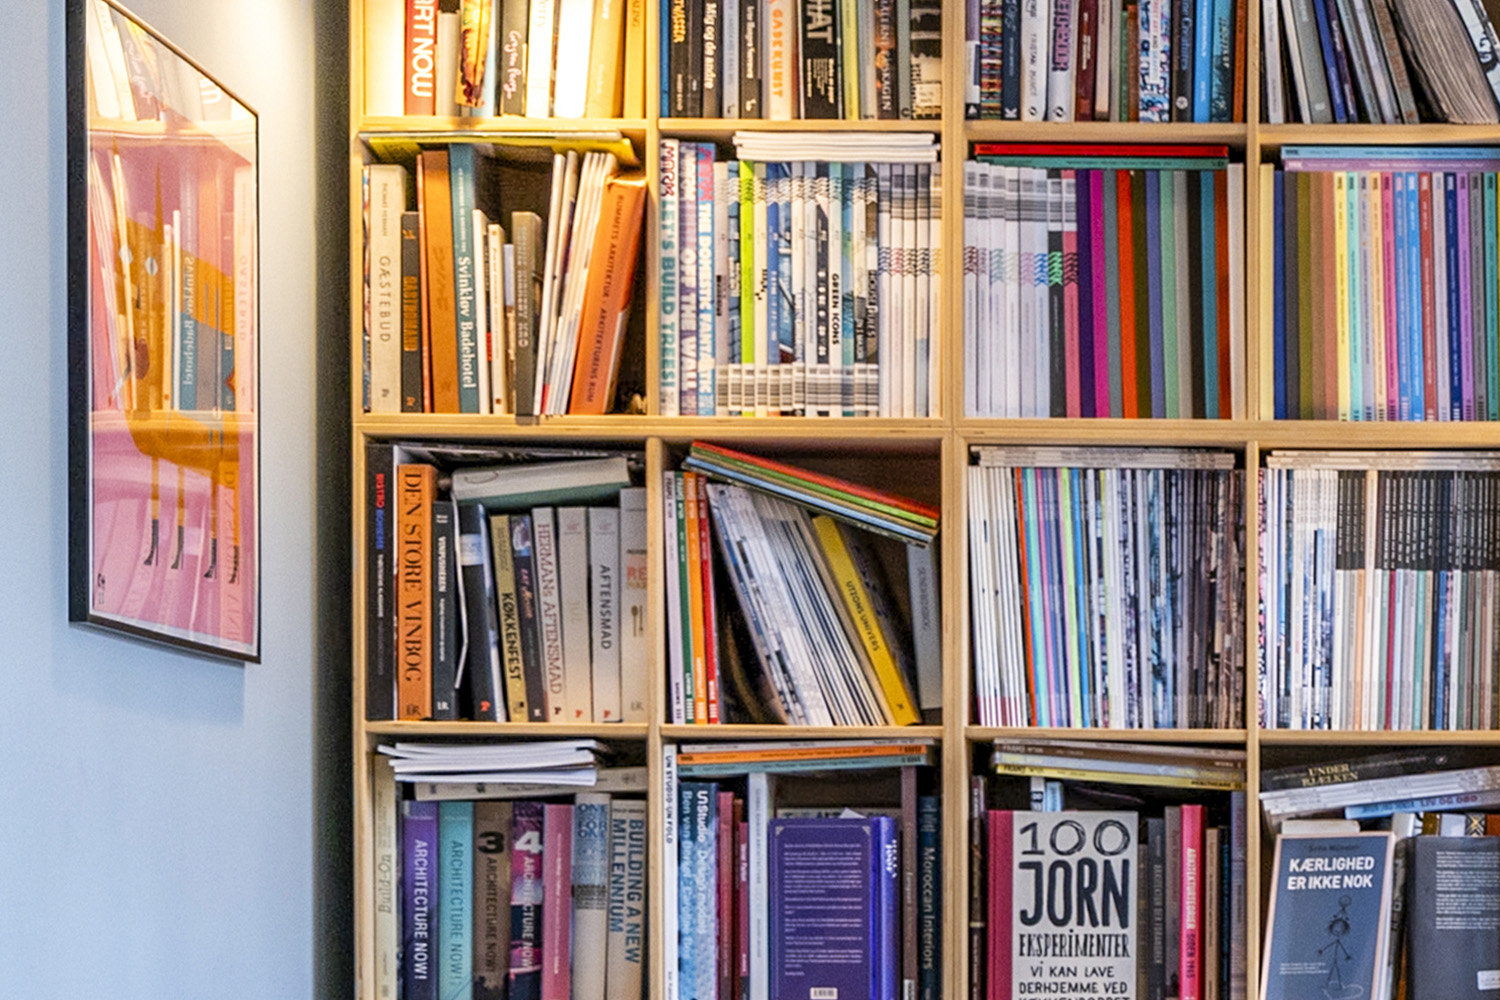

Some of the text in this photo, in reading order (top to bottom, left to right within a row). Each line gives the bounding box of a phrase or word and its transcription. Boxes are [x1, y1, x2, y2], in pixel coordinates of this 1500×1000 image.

[412, 38, 435, 97] NOW
[703, 3, 717, 89] Mig og de andre
[772, 9, 783, 97] GADEKUNST
[379, 256, 391, 343] GÆSTEBUD
[458, 256, 476, 317] Svinkløv
[590, 195, 625, 380] RUMMETS ARKITEKTUR ARKITEKTURENS
[661, 256, 675, 316] BUILD
[831, 273, 839, 345] GREEN ICONS
[459, 320, 480, 388] Badehotel
[661, 322, 675, 388] TREES!
[681, 337, 696, 391] WALL
[402, 472, 422, 683] DEN STORE VINBOG
[600, 564, 613, 650] AFTENSMAD
[501, 592, 522, 681] KØKKENFEST
[548, 601, 565, 695] AFTENSMAD
[861, 614, 880, 652] UNIVERS
[665, 755, 674, 845] UN STUDIO UN FOLD
[681, 790, 692, 813] Ben
[1307, 763, 1350, 777] UNDER
[610, 819, 625, 933] MILLENNIUM
[1019, 819, 1131, 857] 100
[1288, 856, 1376, 873] KÆRLIGHED
[413, 839, 429, 980] ARCHITECTURE NOW!
[450, 840, 465, 980] ARCHITECTURE NOW!
[478, 831, 505, 973] 3 ARCHITECTURE NOW!
[514, 830, 543, 940] 4 ARCHITECTURE
[625, 820, 645, 964] BUILDING A NEW
[922, 846, 936, 970] Moroccan Interiors
[1017, 856, 1131, 930] JORN
[1287, 873, 1374, 891] ER IKKE NOK
[1018, 981, 1129, 995] DERHJEMME VED
[1049, 965, 1116, 979] KAN LAVE
